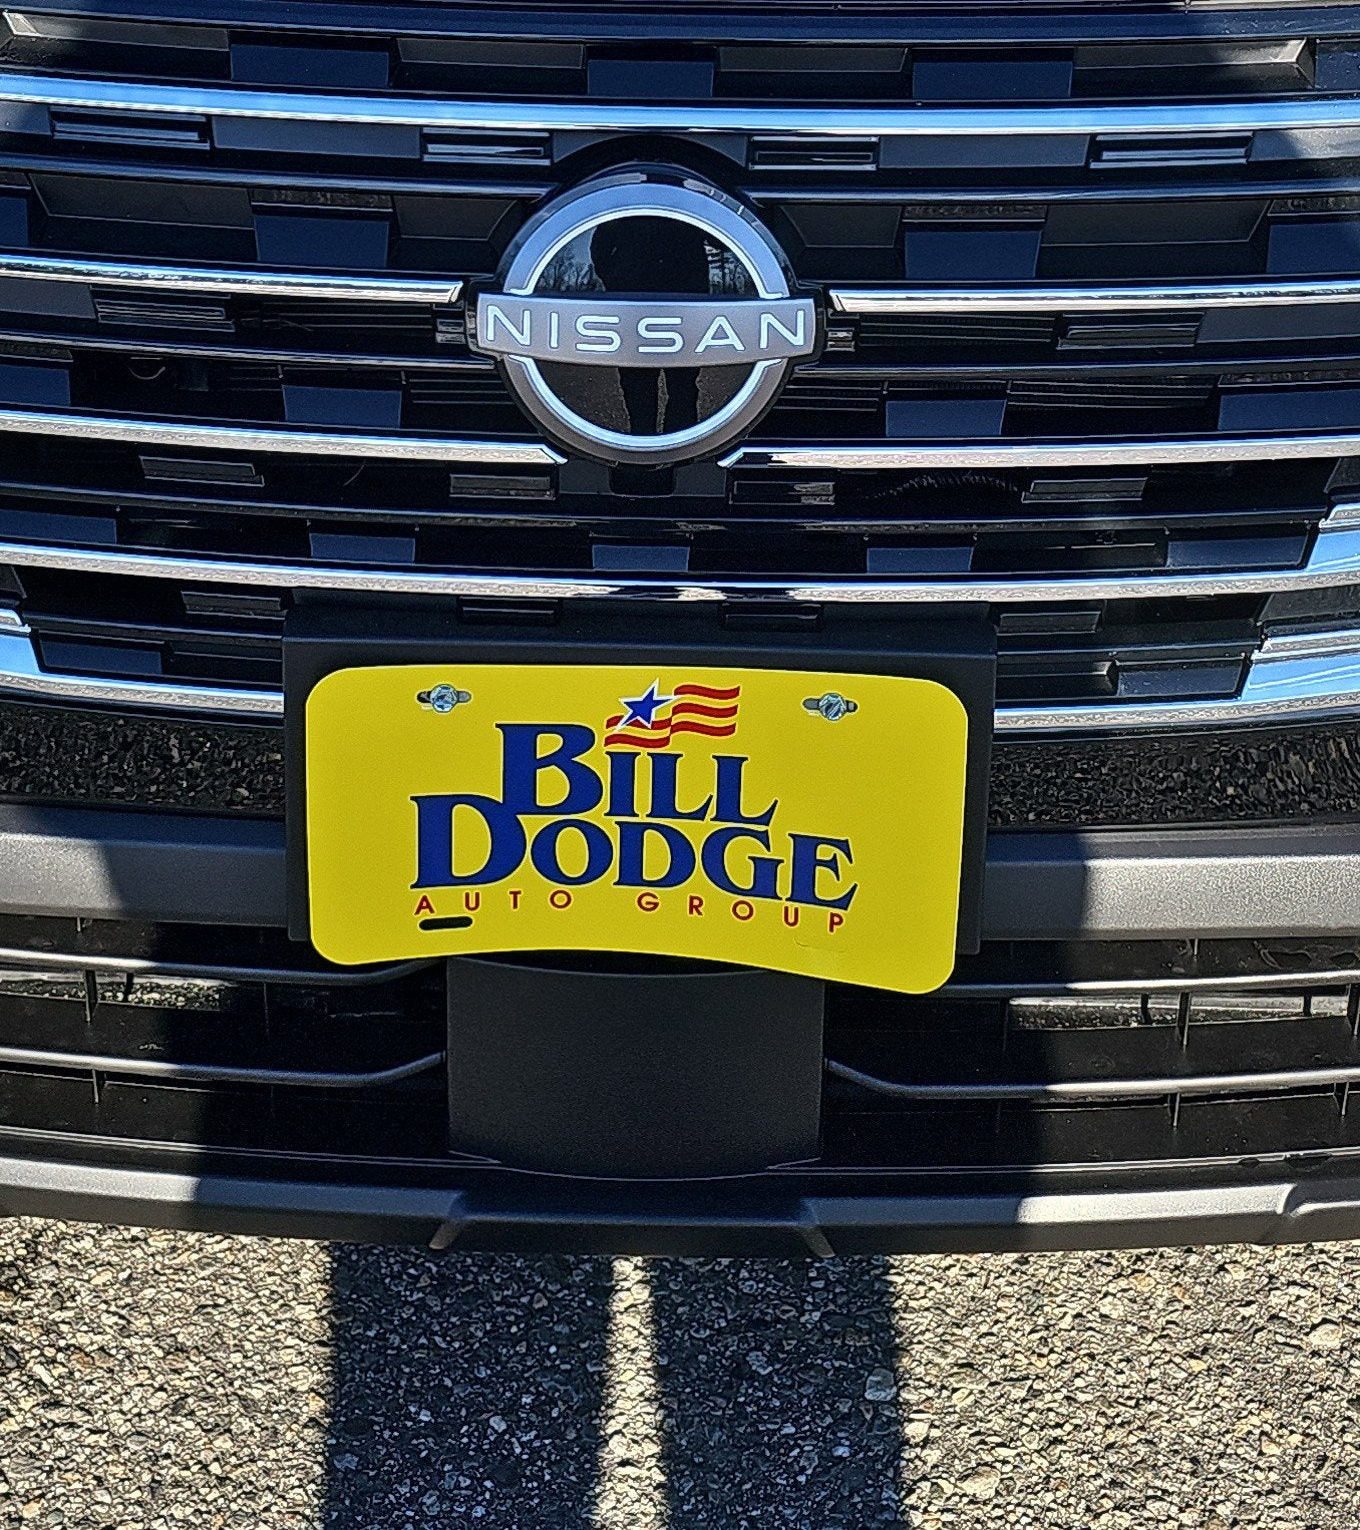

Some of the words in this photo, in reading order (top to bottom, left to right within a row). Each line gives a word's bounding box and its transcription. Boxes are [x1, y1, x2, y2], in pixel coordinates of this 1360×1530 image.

[485, 304, 806, 354] NISSAN
[495, 722, 779, 827] BILL
[409, 792, 859, 912] DODGE
[413, 889, 574, 917] AUTO
[637, 891, 845, 935] GROUP
